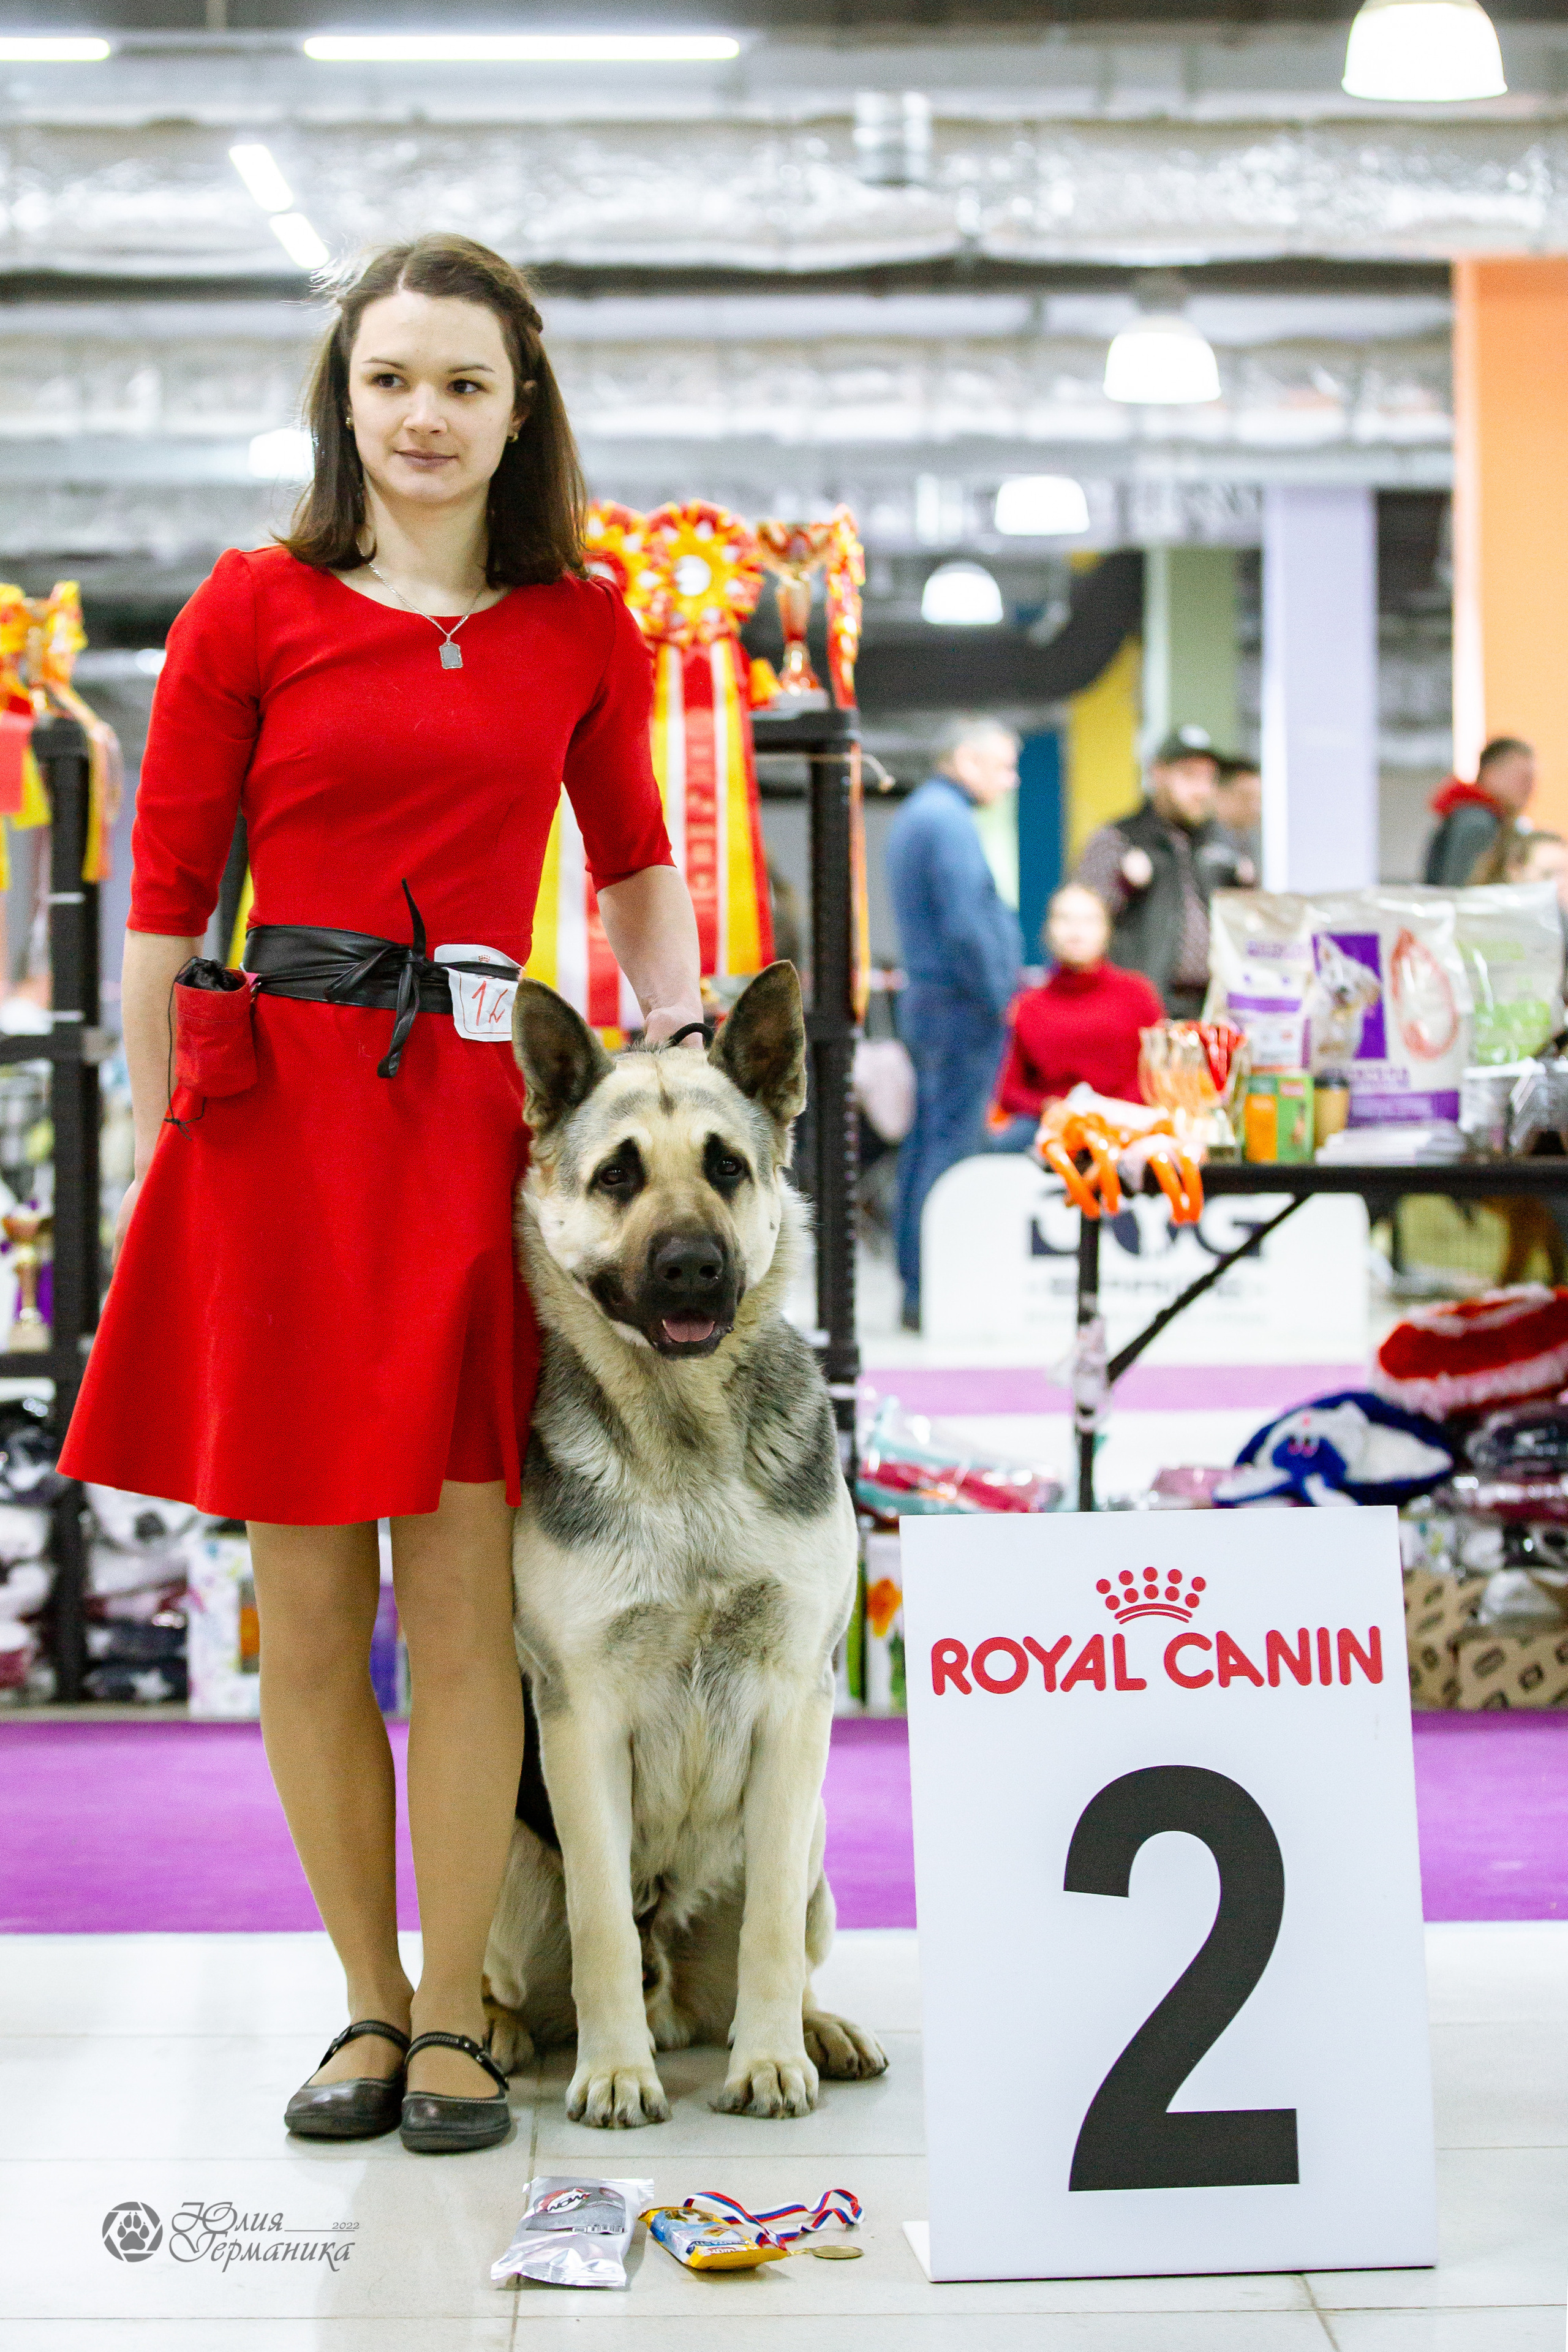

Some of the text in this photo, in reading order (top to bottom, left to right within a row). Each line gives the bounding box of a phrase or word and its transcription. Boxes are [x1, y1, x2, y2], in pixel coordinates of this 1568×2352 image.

[930, 1626, 1383, 1695] ROYAL CANIN
[1063, 1765, 1300, 2192] 2
